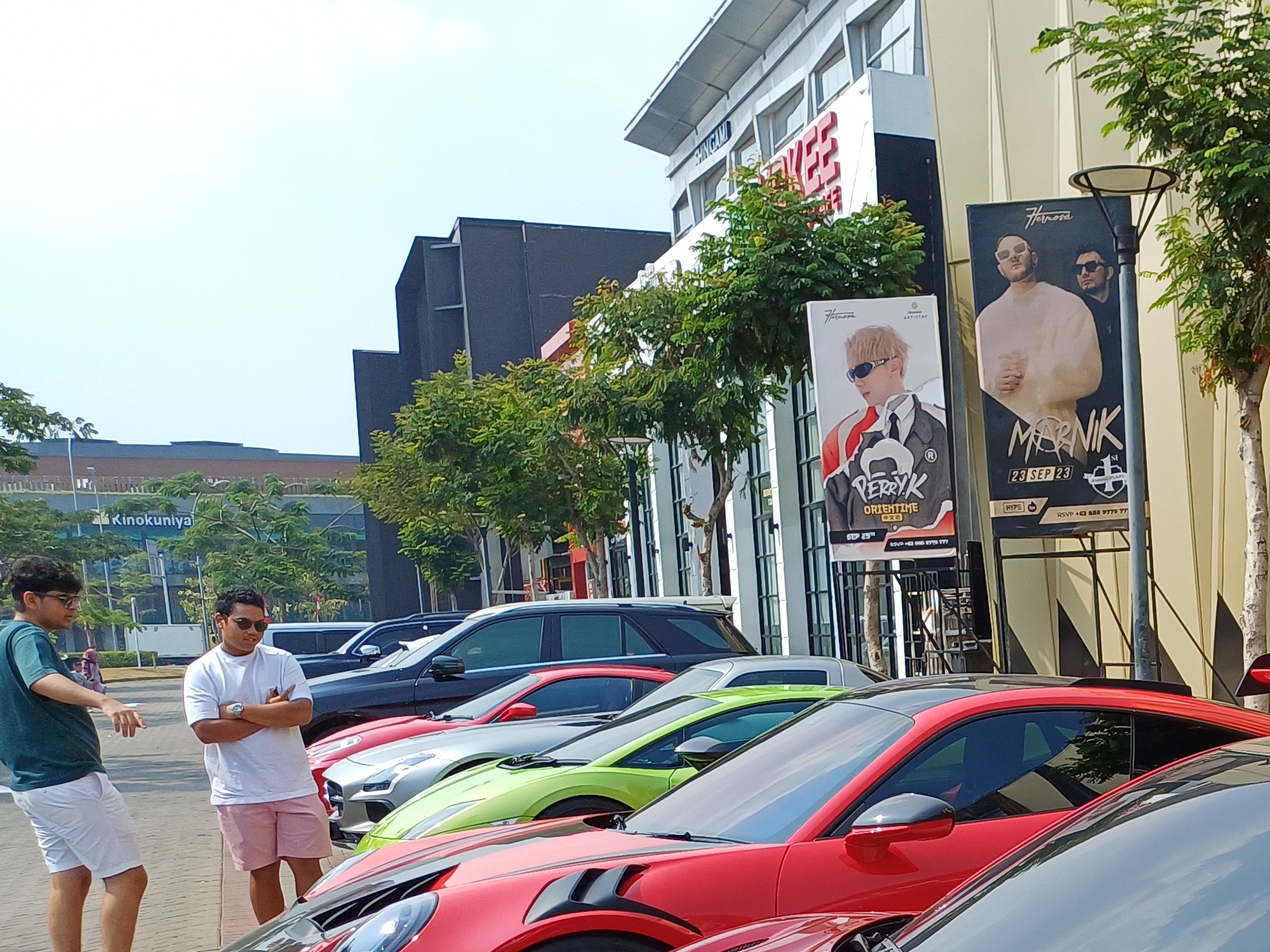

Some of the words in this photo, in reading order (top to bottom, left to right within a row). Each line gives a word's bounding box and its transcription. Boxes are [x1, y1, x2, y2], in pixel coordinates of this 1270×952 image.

[1025, 204, 1073, 230] Hermosa
[1008, 405, 1123, 464] MARNIK
[1011, 470, 1027, 482] 23
[1030, 468, 1051, 480] SEP
[1056, 467, 1071, 479] 23
[863, 502, 919, 515] ORIENTIME
[112, 513, 192, 529] Kinokuniya
